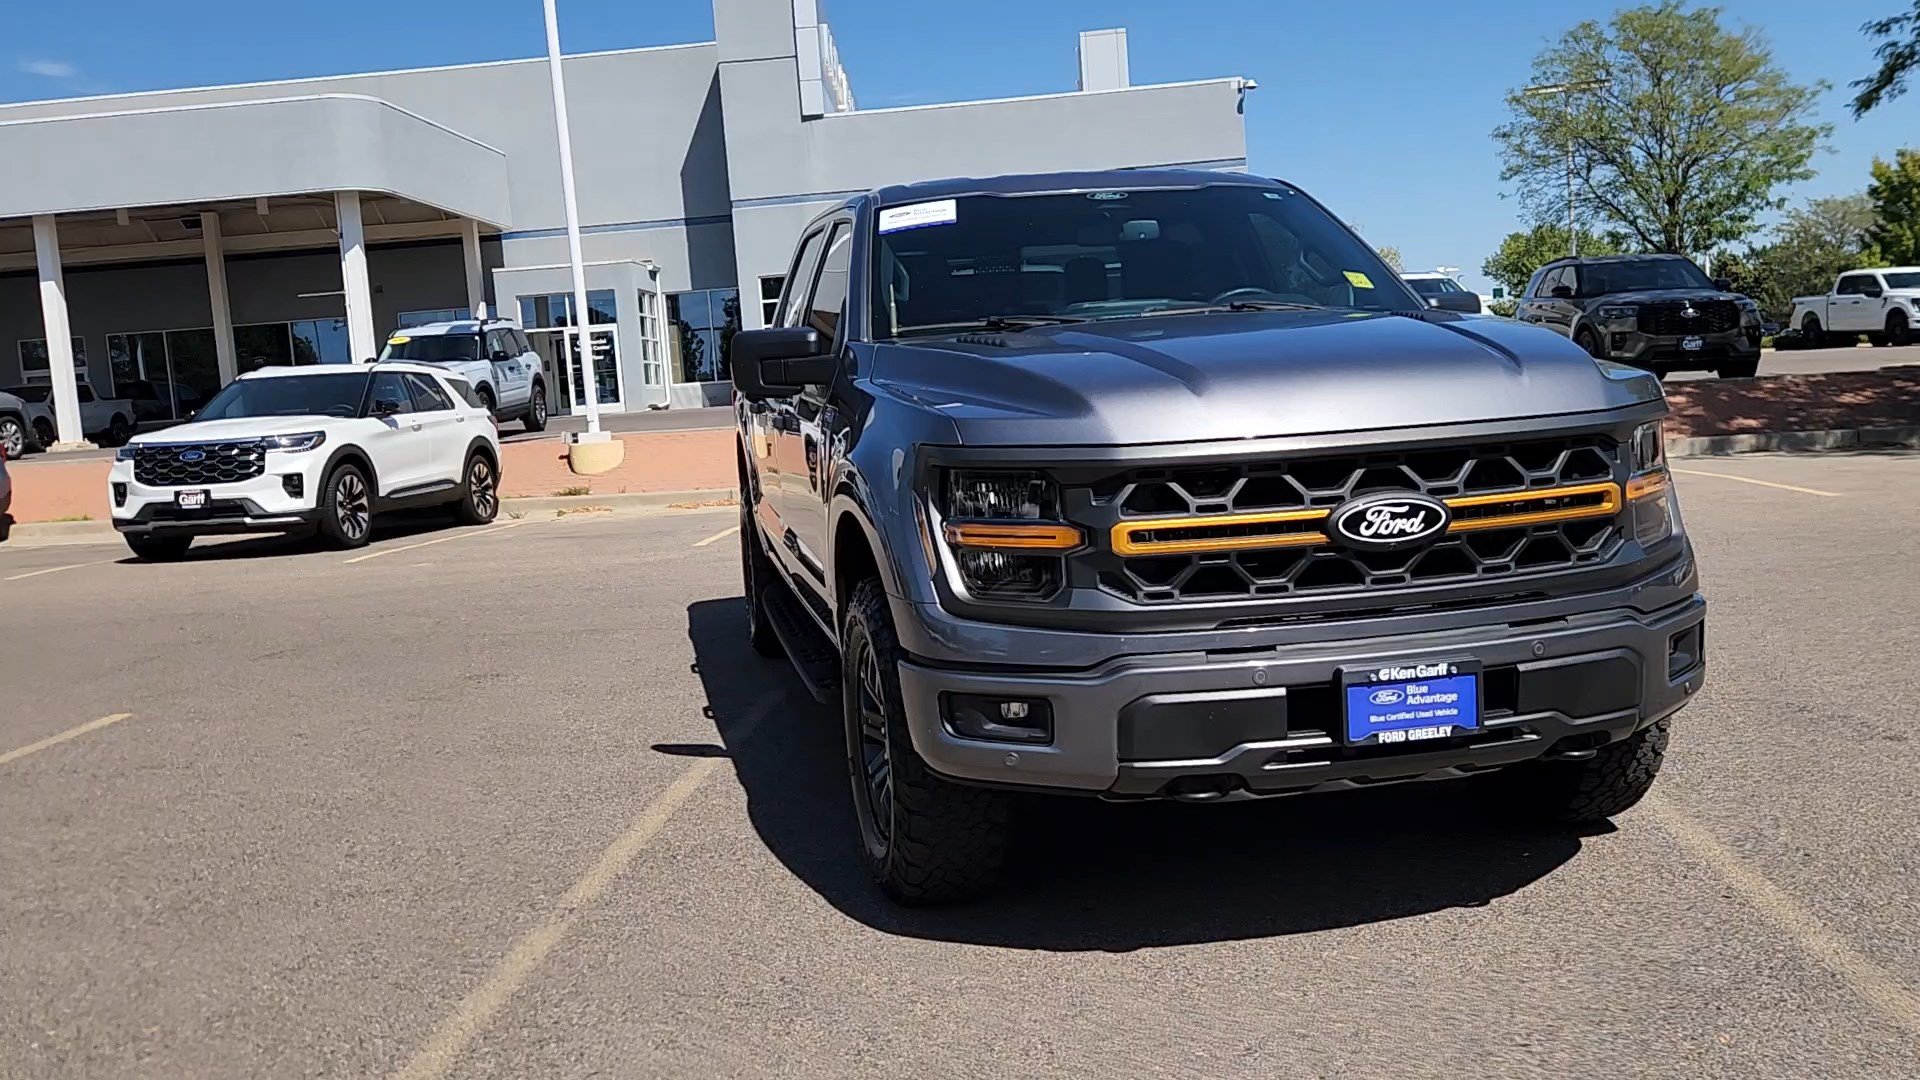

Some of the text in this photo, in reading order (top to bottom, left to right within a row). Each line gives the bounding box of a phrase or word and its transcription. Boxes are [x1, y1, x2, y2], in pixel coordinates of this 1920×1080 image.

[179, 493, 206, 505] Garff
[1359, 505, 1426, 537] Ford
[1390, 662, 1448, 680] Ken Garff
[1375, 690, 1399, 702] Ford
[1406, 684, 1428, 695] Blue
[1406, 693, 1458, 705] Advantage
[1369, 708, 1458, 723] Blue Certified Used Vehicle
[1379, 725, 1452, 743] FORD GREELEY
